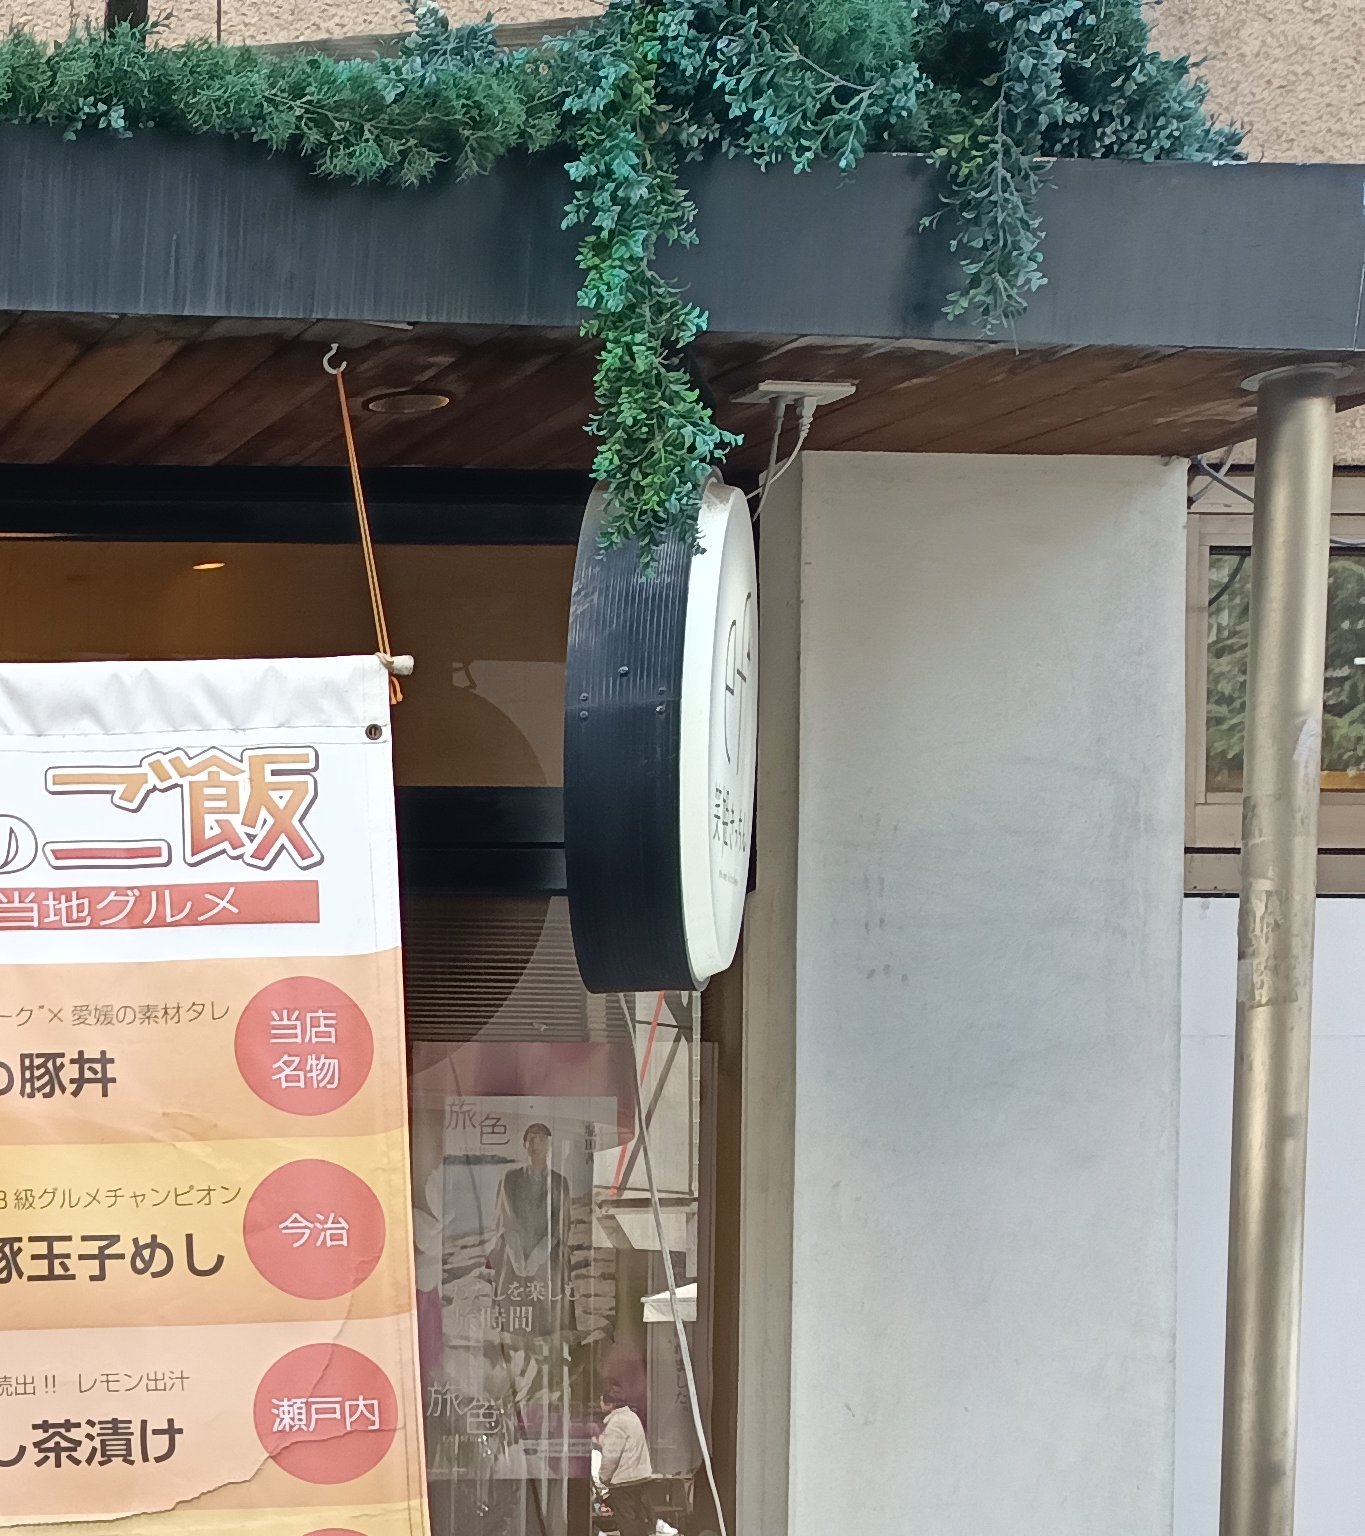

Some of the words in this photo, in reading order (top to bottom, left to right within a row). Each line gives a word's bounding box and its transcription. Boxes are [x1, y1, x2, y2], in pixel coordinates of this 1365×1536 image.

[268, 1009, 338, 1045] 当店
[271, 1053, 341, 1092] 名物
[278, 1212, 351, 1249] 今治
[76, 1369, 191, 1395] レモン出汁
[270, 1394, 381, 1433] 瀬戸内
